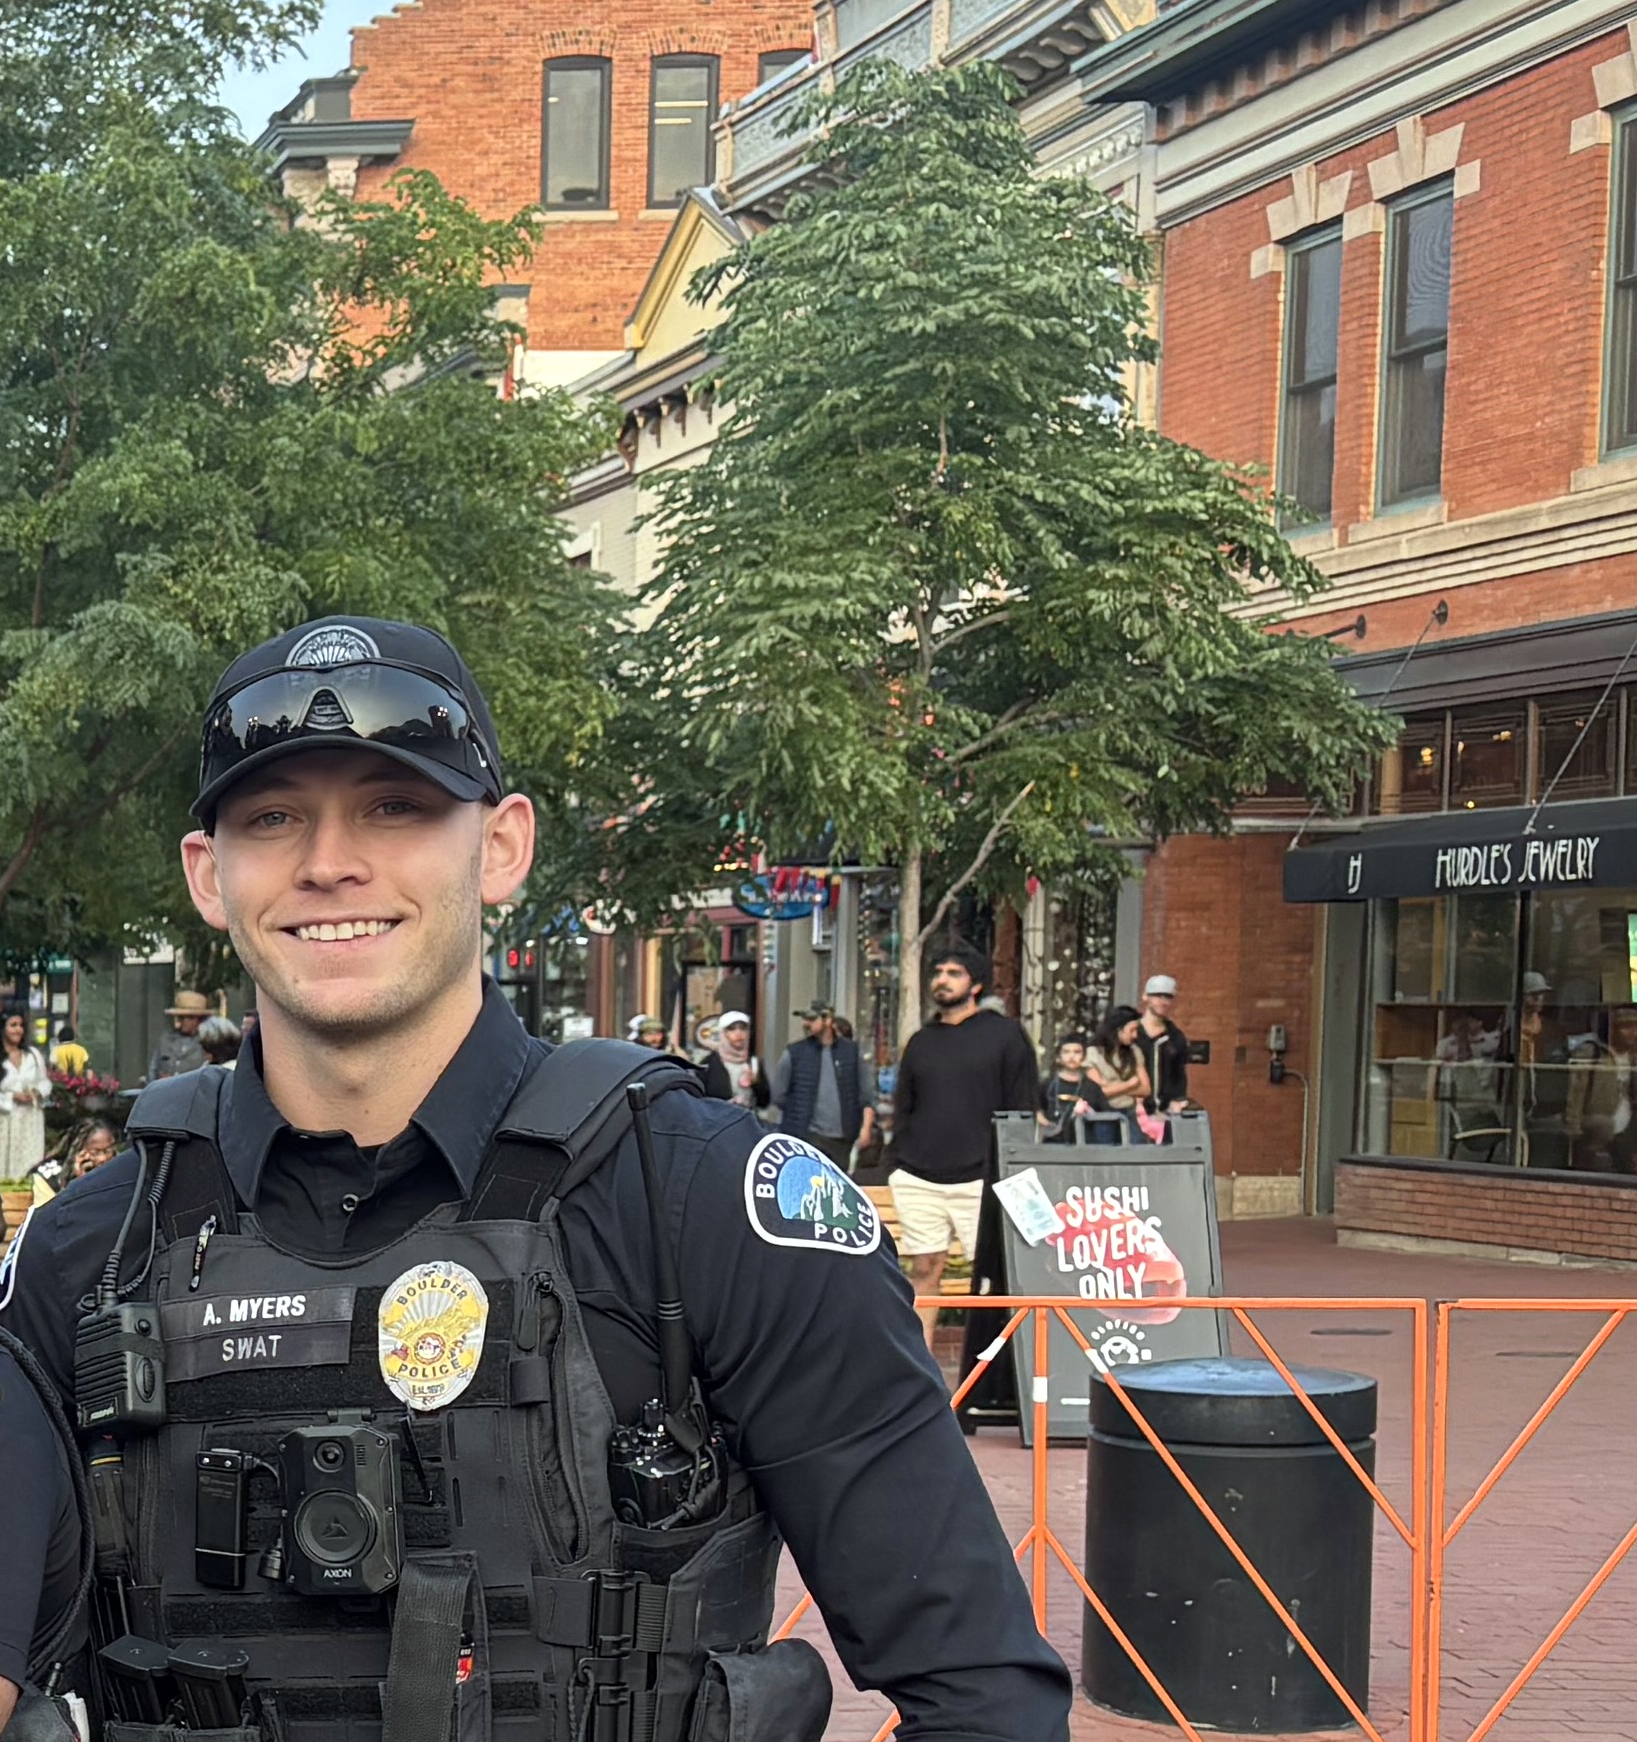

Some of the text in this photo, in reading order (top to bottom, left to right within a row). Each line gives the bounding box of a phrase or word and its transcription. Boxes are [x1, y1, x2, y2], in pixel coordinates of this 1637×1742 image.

[1435, 836, 1601, 888] HURDLE'S JEWELRY
[1065, 1185, 1149, 1228] SUSHI
[813, 1202, 874, 1247] POLICE
[1057, 1215, 1162, 1273] LOVERS
[396, 1277, 468, 1306] BOULDER
[1078, 1262, 1147, 1300] ONLY
[203, 1295, 307, 1326] A. MYERS
[222, 1335, 282, 1362] SWAT
[397, 1359, 462, 1378] POLICE
[323, 1568, 353, 1579] AXON
